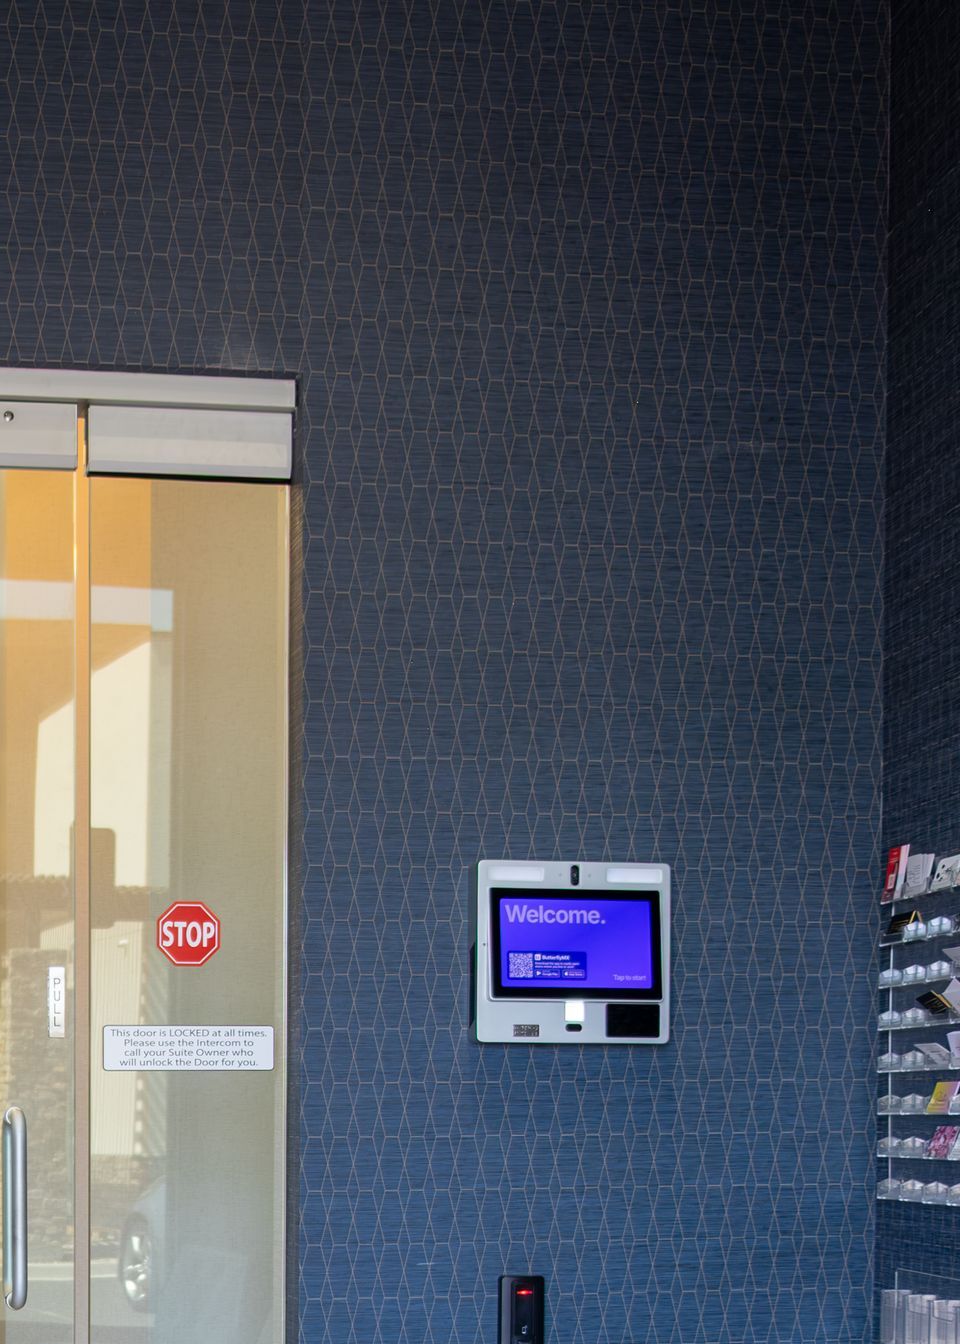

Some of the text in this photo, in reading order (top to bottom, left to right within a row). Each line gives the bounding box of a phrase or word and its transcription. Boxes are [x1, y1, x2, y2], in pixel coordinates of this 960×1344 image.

[505, 904, 606, 925] Welcome.
[162, 920, 216, 948] STOP
[53, 977, 61, 1027] PULL
[111, 1029, 131, 1037] This
[133, 1029, 157, 1037] door
[159, 1029, 167, 1037] is
[169, 1029, 210, 1037] LOCKED
[224, 1029, 235, 1037] all
[238, 1029, 267, 1037] times.
[124, 1039, 155, 1047] Please
[178, 1039, 194, 1047] the
[196, 1039, 241, 1047] Intercom
[124, 1048, 254, 1058] call your Suite Owner who
[120, 1058, 258, 1068] will unlock the Door for you.
